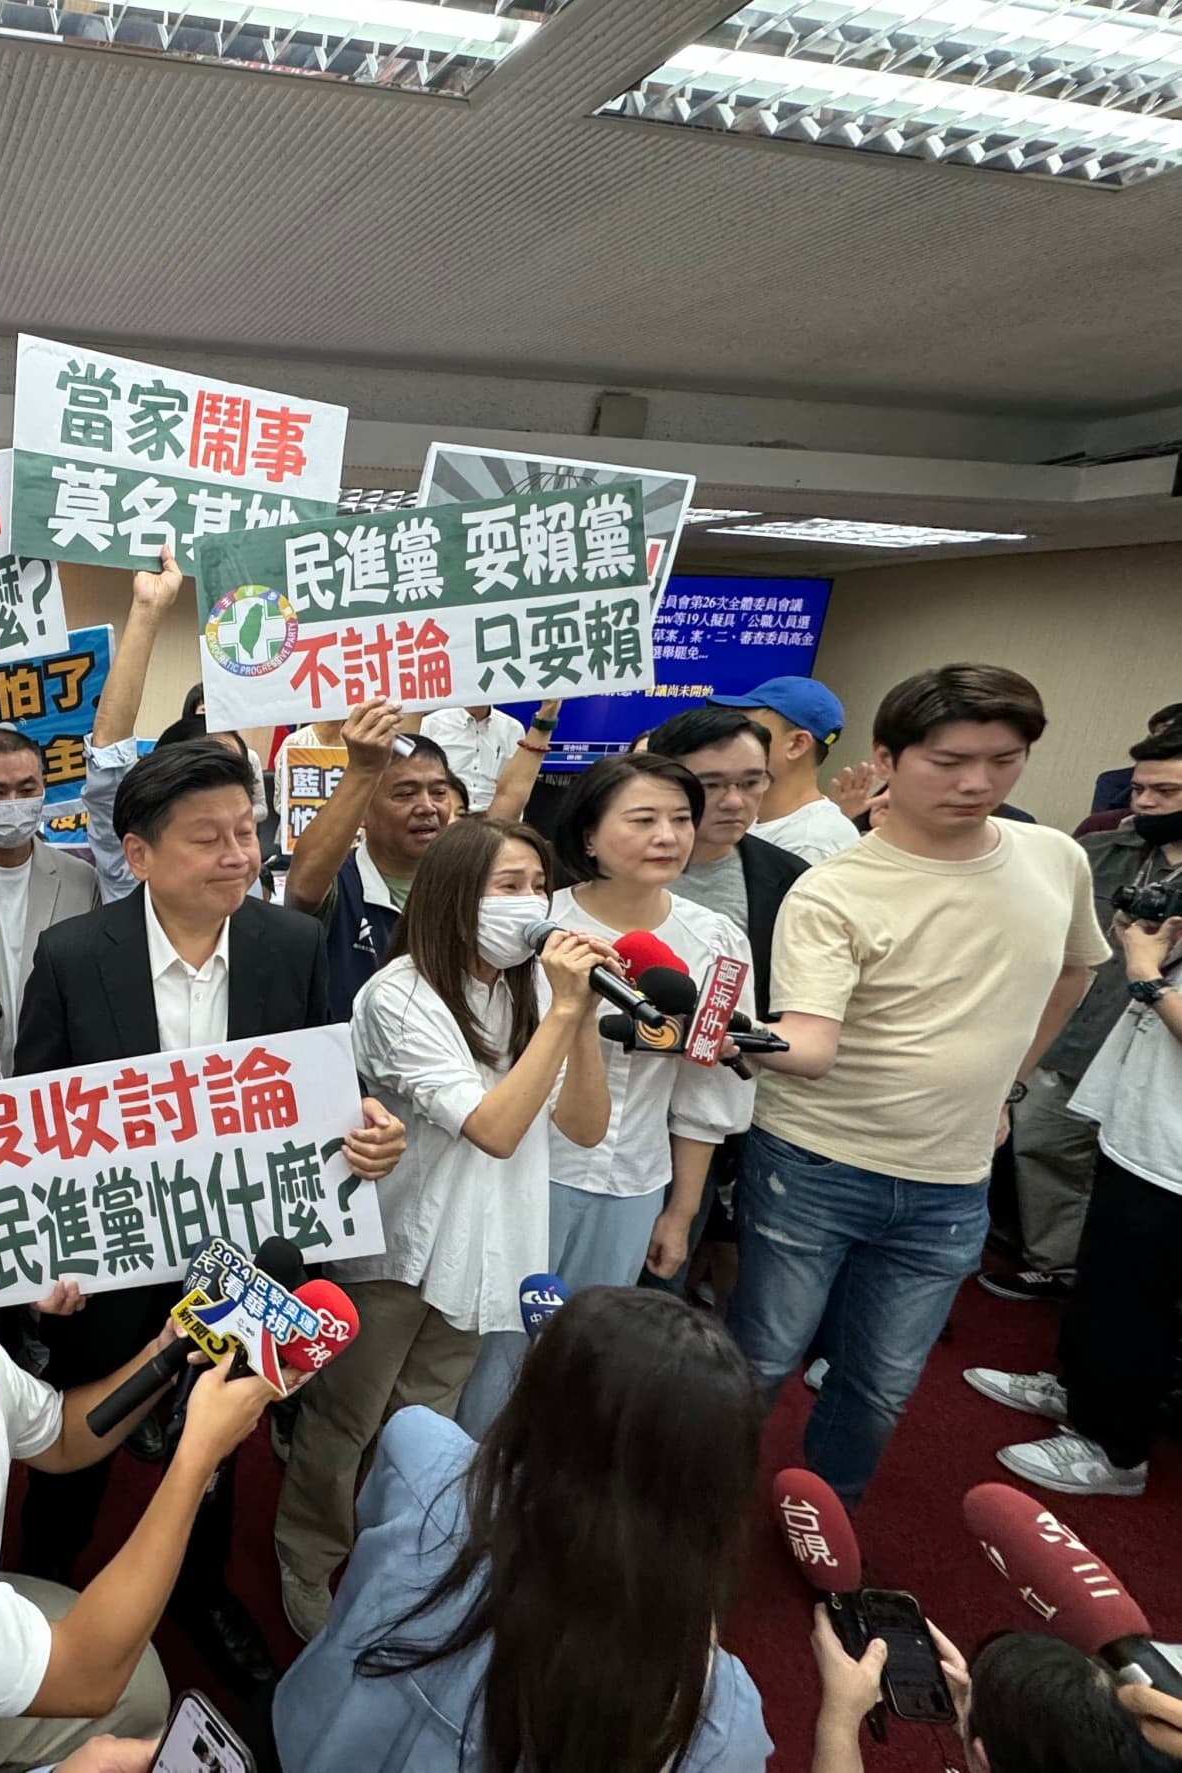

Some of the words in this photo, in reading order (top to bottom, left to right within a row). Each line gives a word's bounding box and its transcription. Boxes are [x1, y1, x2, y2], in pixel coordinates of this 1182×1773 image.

[55, 359, 313, 483] 當家鬧事
[285, 515, 445, 611] 民進黨
[461, 492, 636, 596] 耍賴黨
[289, 617, 452, 710] 不討論
[475, 598, 643, 693] 只耍賴
[213, 1243, 252, 1281] 2024
